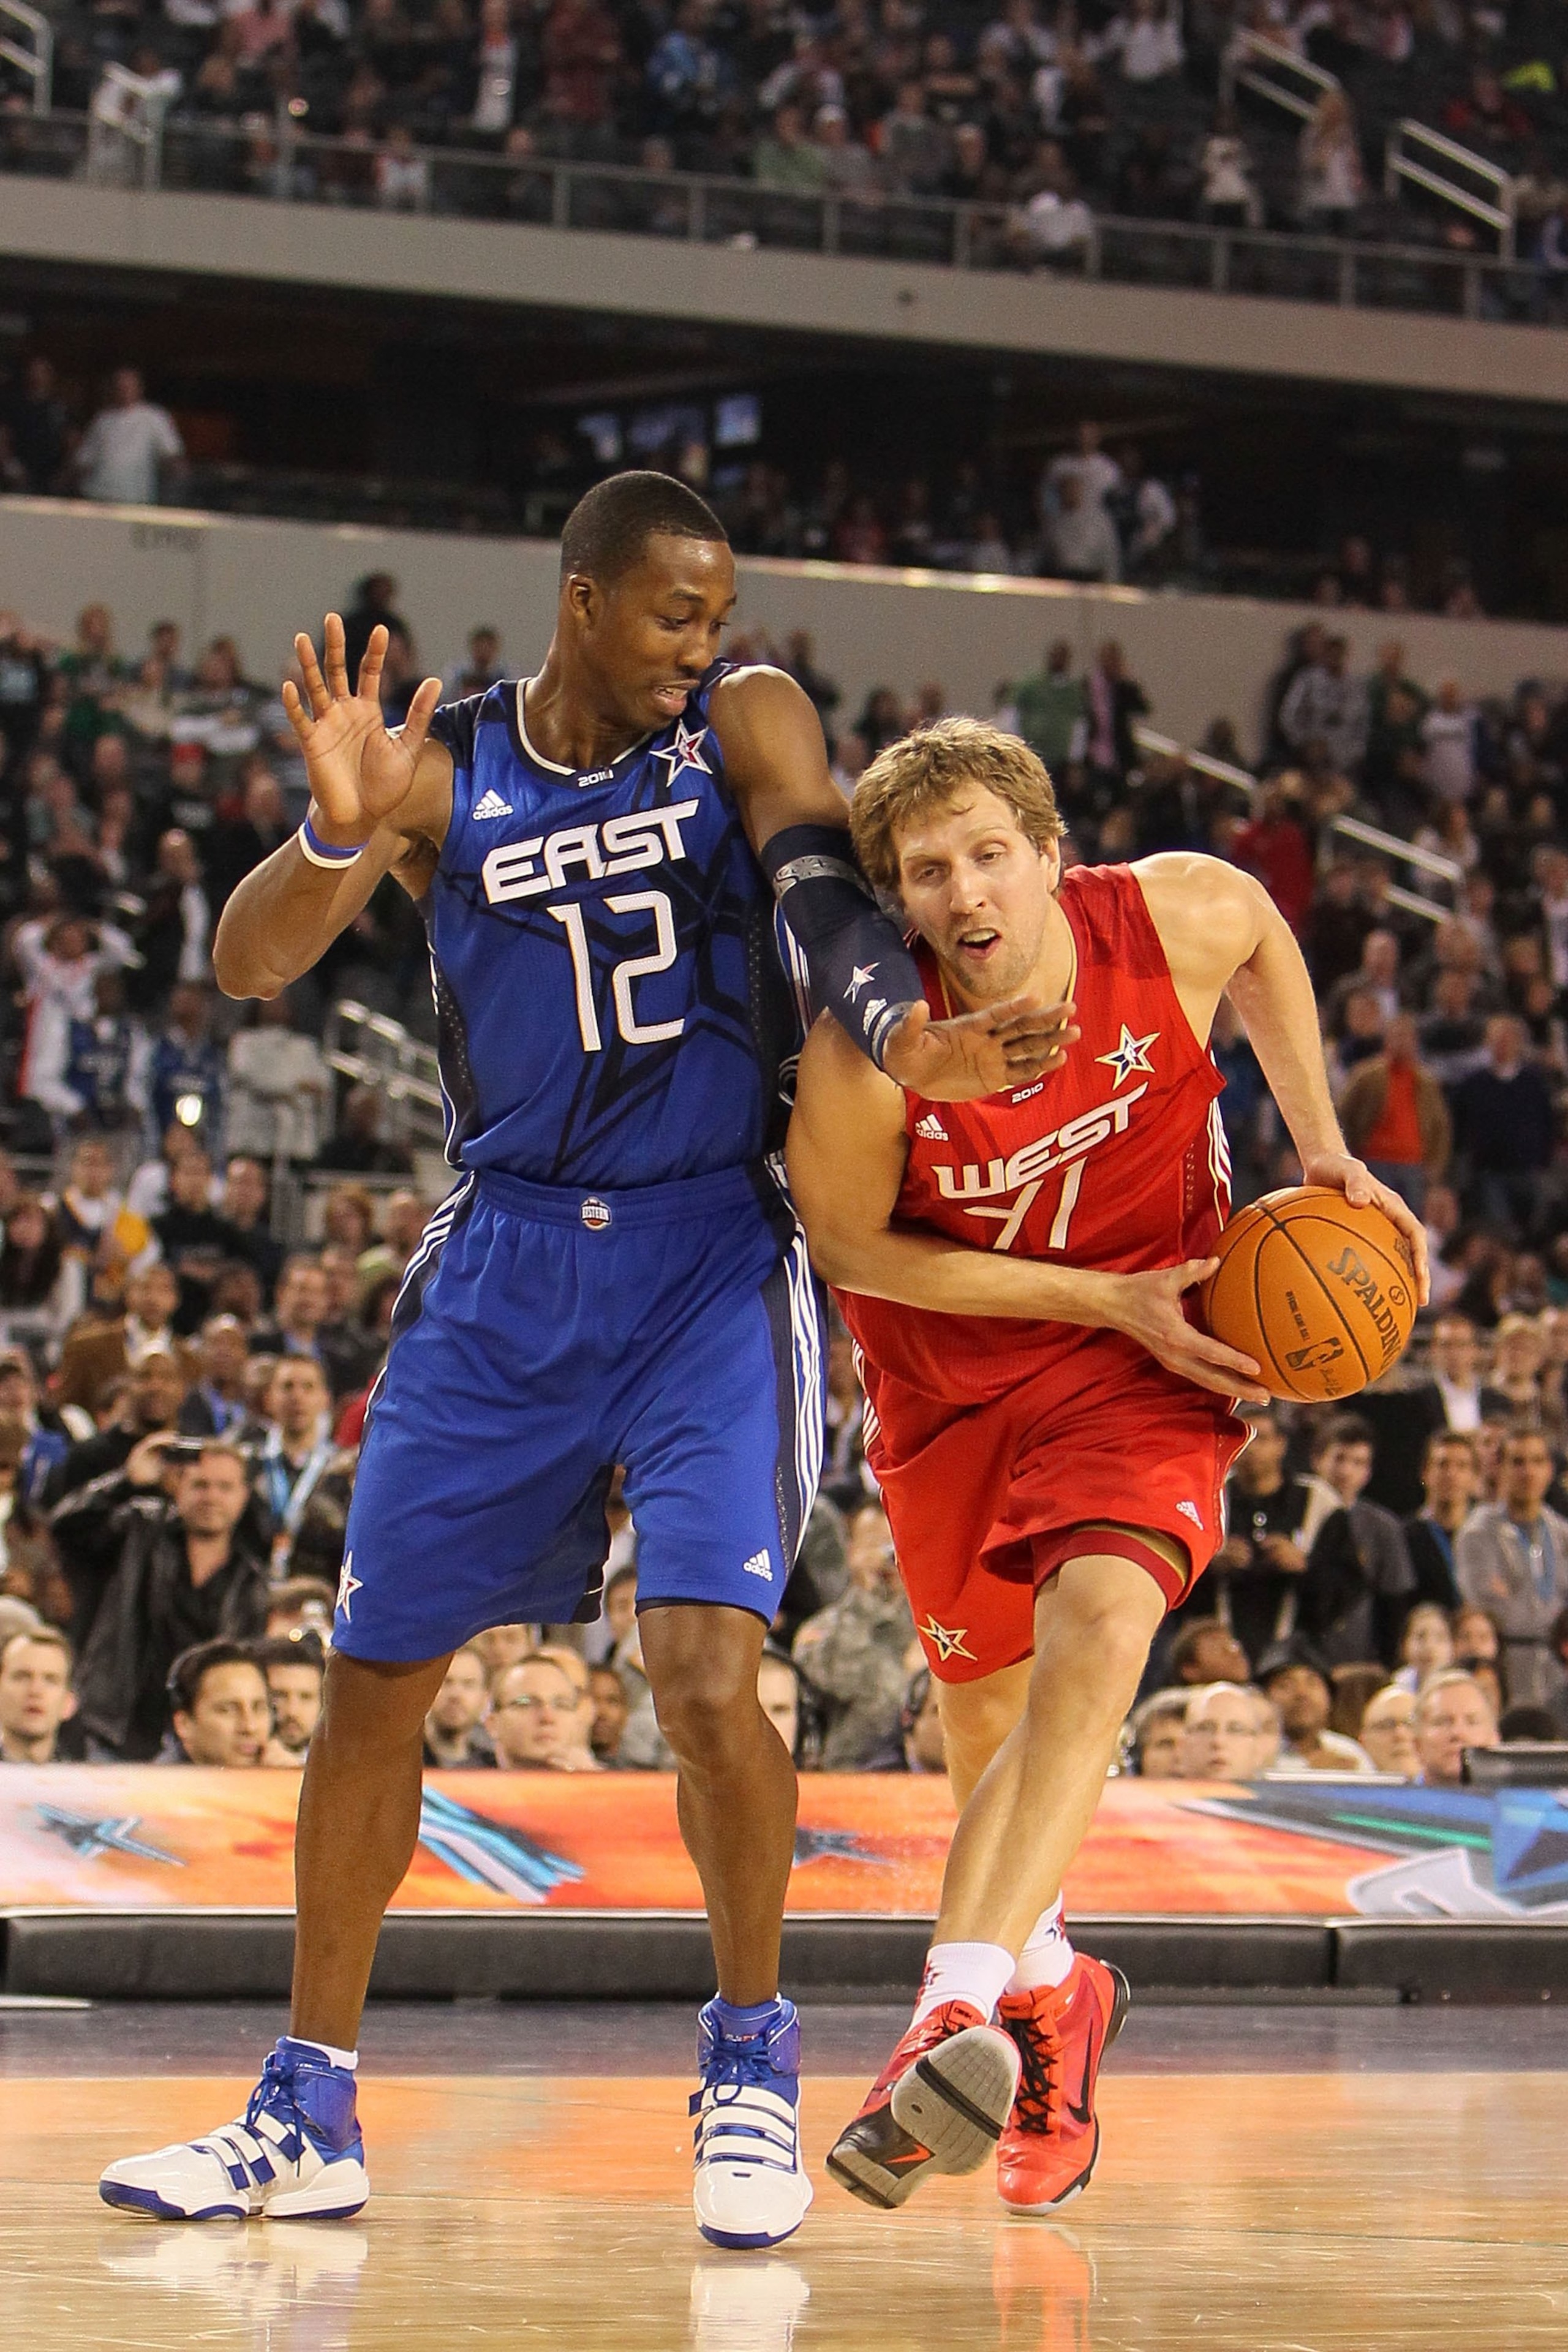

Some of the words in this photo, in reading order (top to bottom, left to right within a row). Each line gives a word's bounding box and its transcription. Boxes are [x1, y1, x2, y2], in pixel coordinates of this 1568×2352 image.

[472, 805, 514, 820] adidas
[481, 799, 699, 904] EAST
[547, 890, 685, 1052] 12
[1012, 1082, 1044, 1104] 2010
[930, 1082, 1148, 1199] WEST
[744, 1562, 772, 1581] adidas
